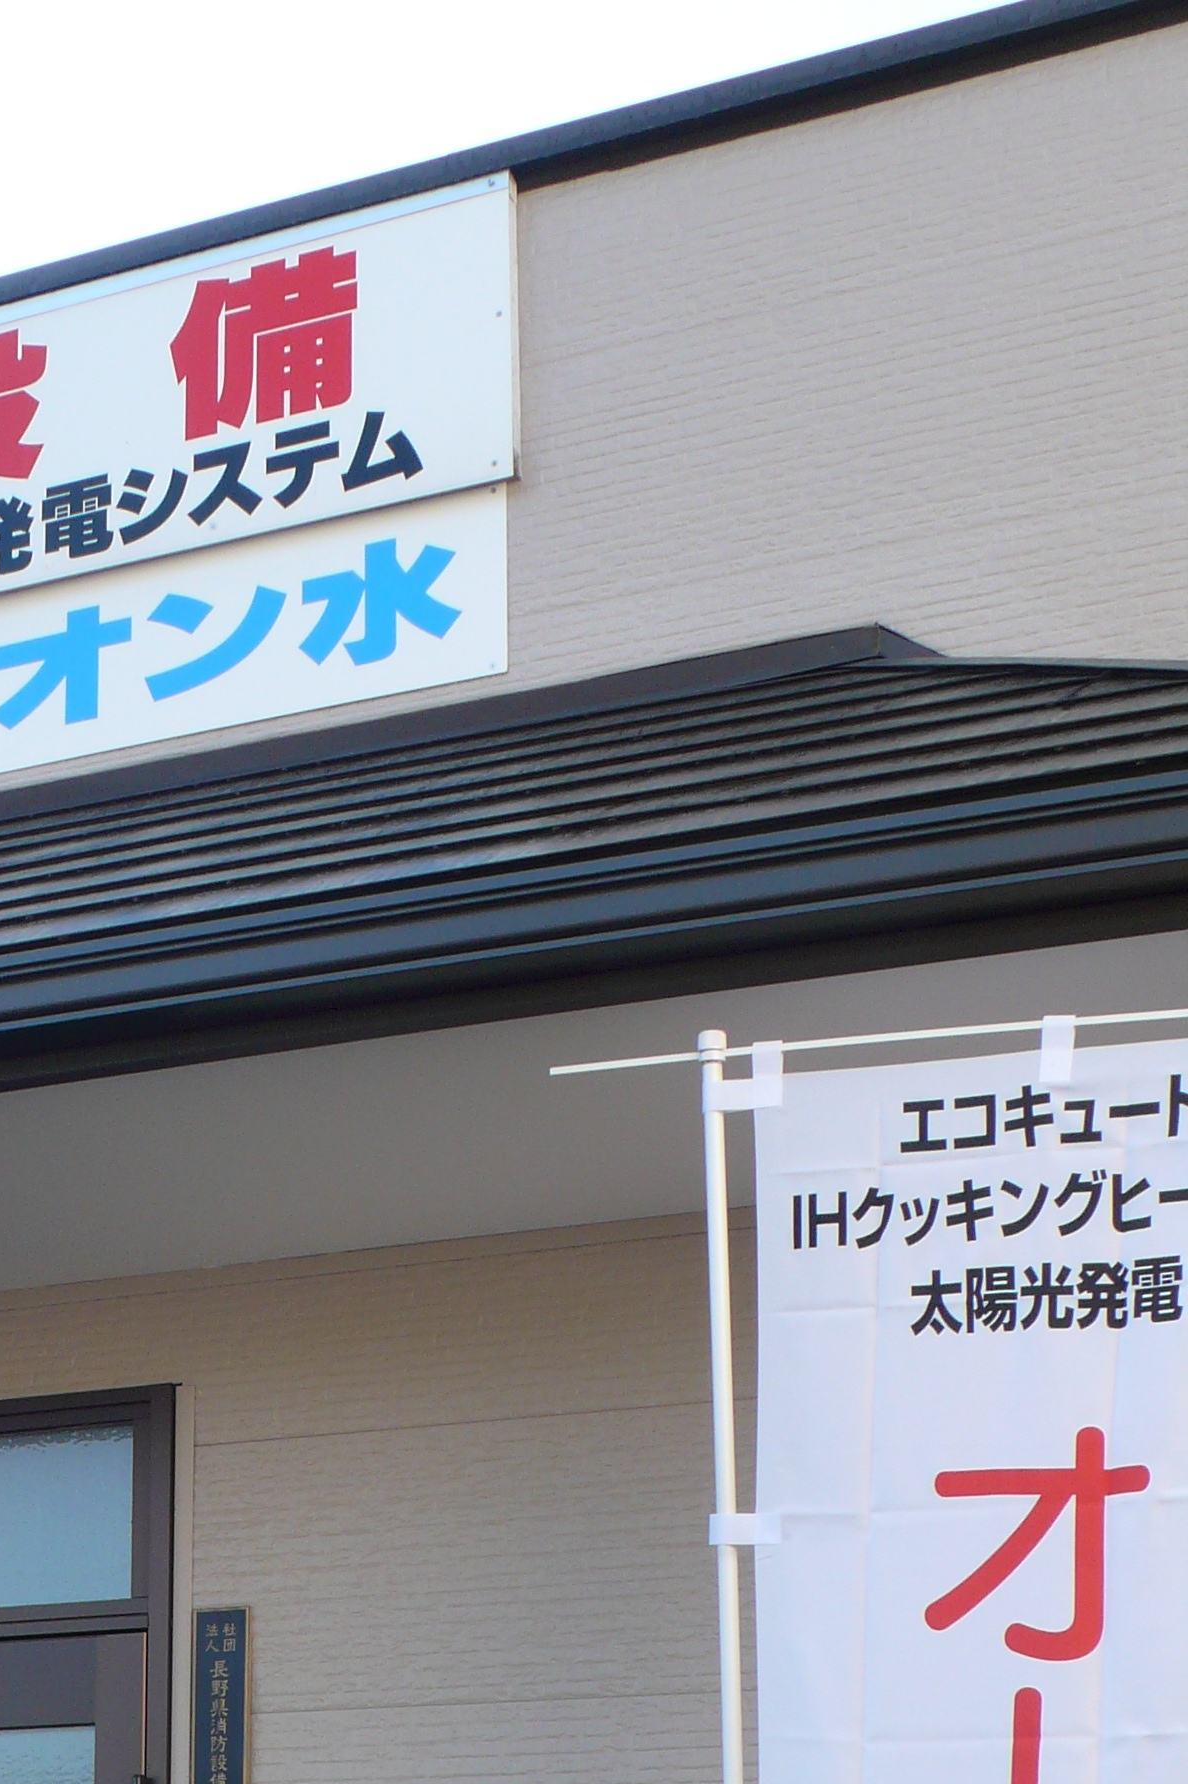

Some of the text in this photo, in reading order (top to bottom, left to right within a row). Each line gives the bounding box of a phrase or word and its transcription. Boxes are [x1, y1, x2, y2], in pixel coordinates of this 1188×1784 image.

[910, 1254, 1184, 1337] 太陽光発電
